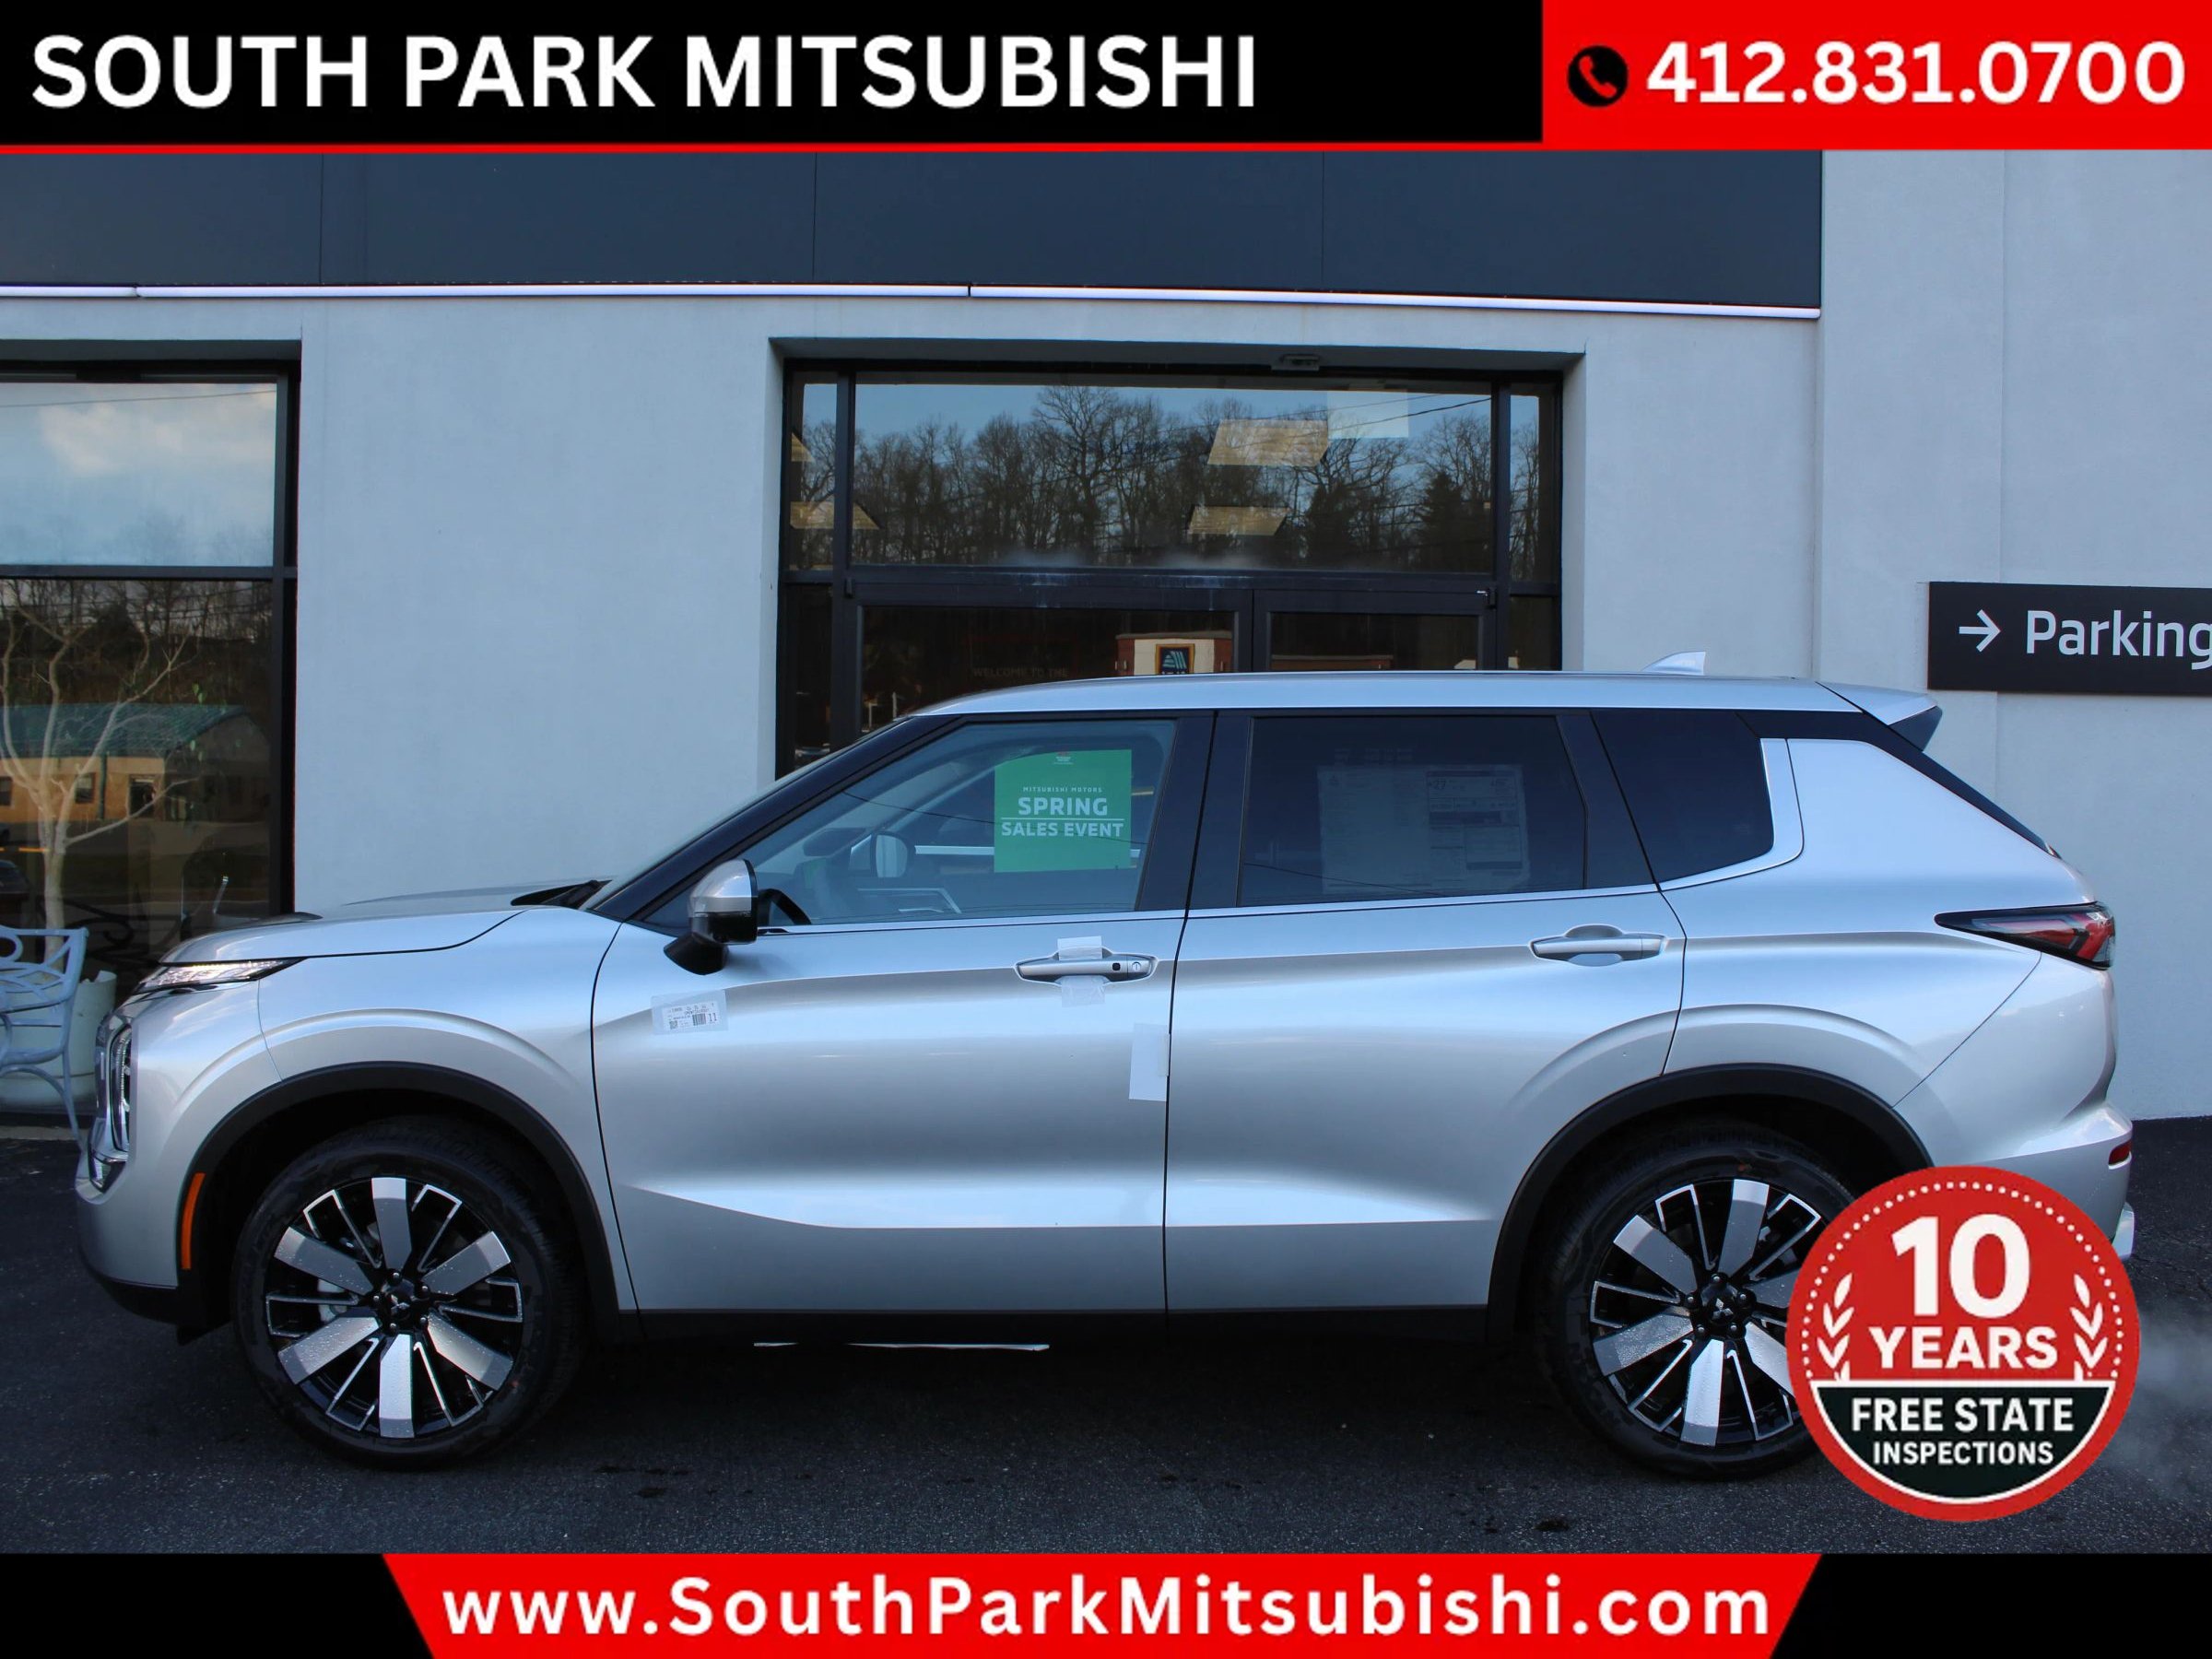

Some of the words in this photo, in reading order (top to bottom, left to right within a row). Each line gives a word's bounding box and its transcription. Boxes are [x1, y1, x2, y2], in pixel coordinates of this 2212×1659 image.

[2026, 609, 2212, 671] Parking
[1018, 796, 1108, 816] SPRING
[1001, 821, 1058, 837] SALES
[1064, 822, 1124, 838] EVENT
